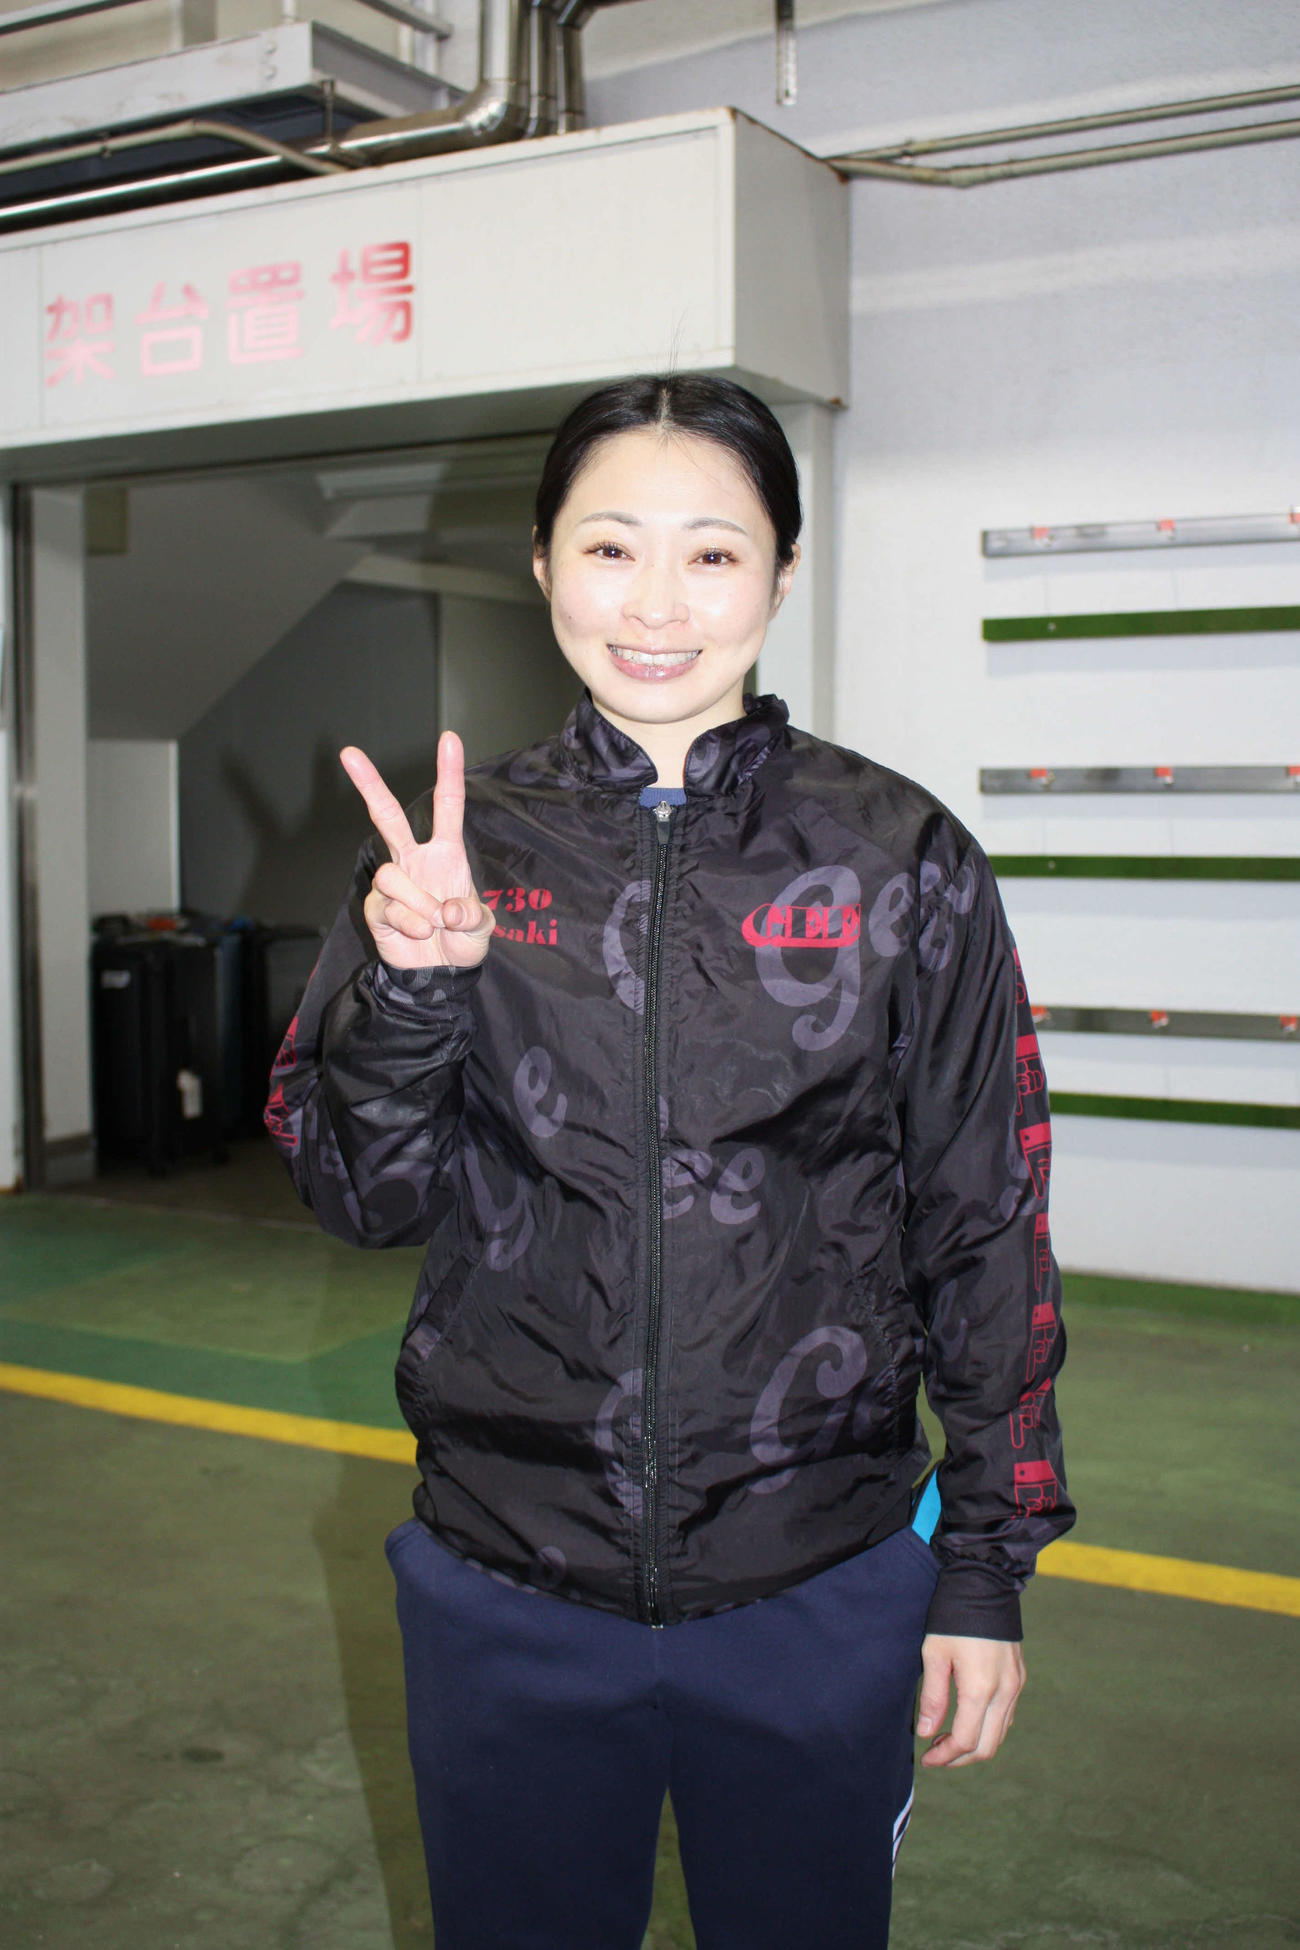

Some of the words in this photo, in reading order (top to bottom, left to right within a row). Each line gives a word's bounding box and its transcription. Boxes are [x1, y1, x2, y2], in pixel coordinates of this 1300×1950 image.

[45, 241, 414, 388] 架台置場
[481, 887, 553, 913] 730
